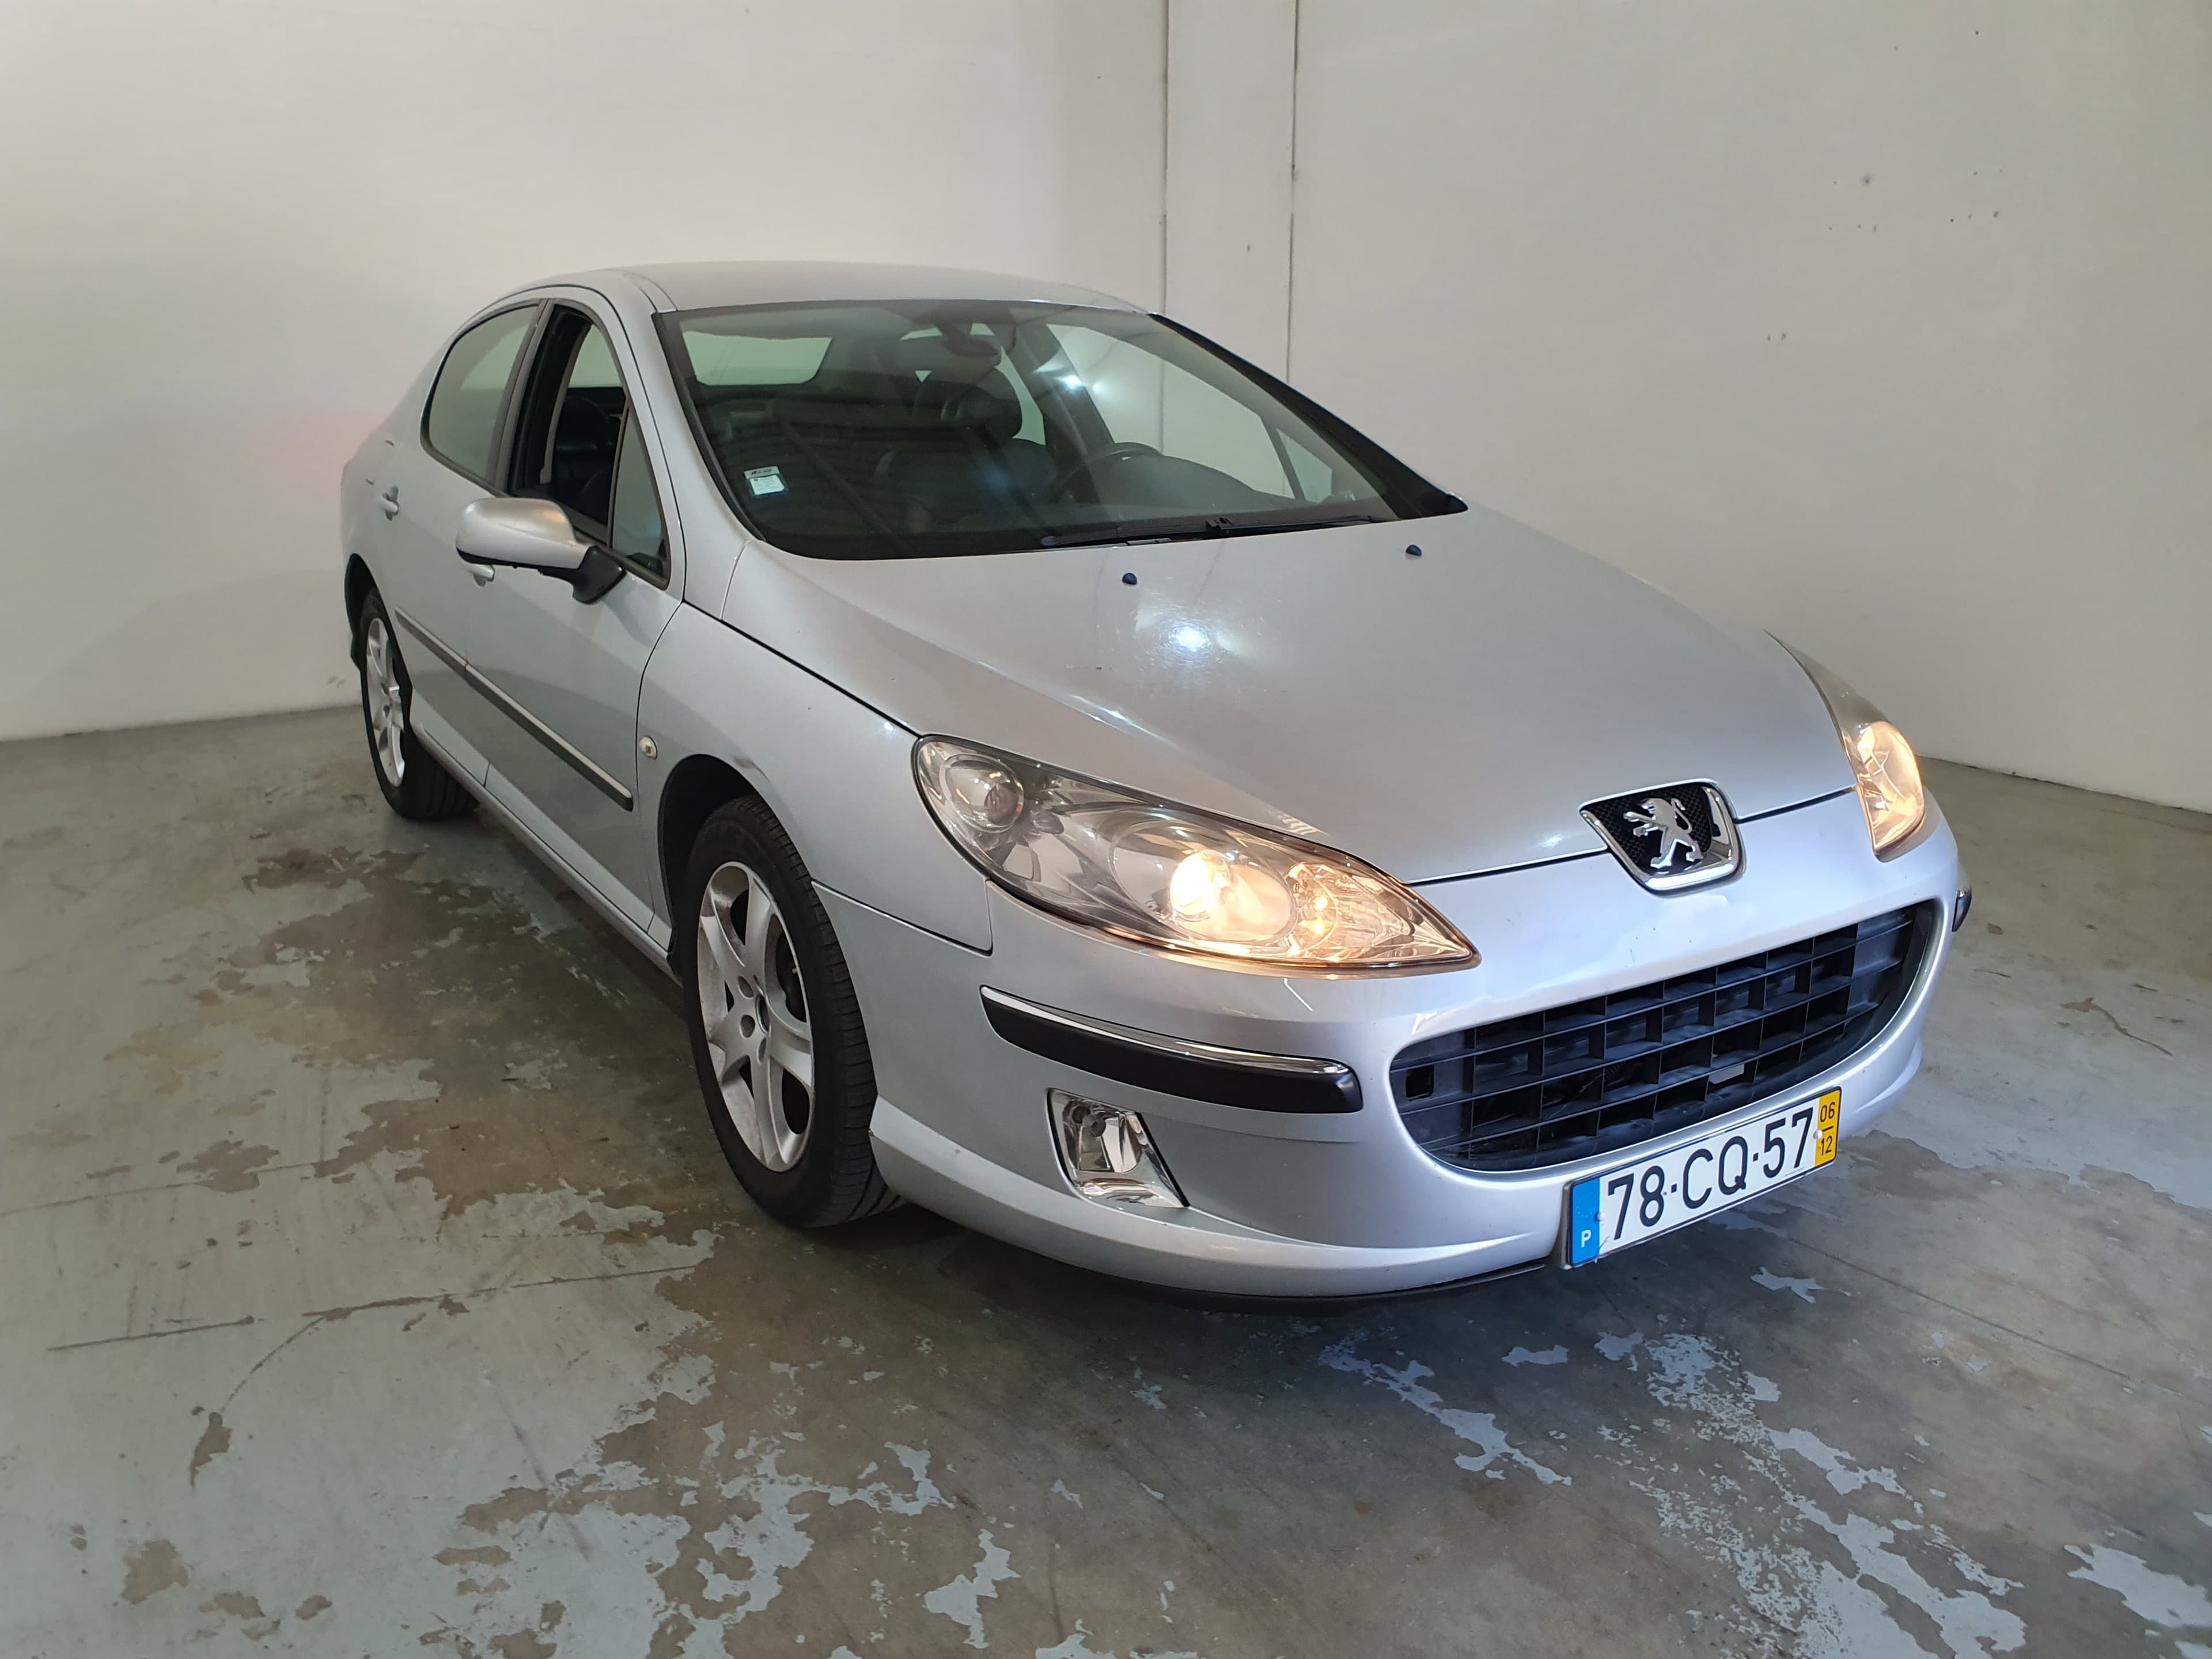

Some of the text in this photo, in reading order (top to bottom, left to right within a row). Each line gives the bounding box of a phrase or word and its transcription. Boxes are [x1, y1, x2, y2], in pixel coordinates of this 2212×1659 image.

[1820, 1101, 1835, 1123] 06
[1821, 1135, 1832, 1156] 12
[1581, 1229, 1592, 1248] P
